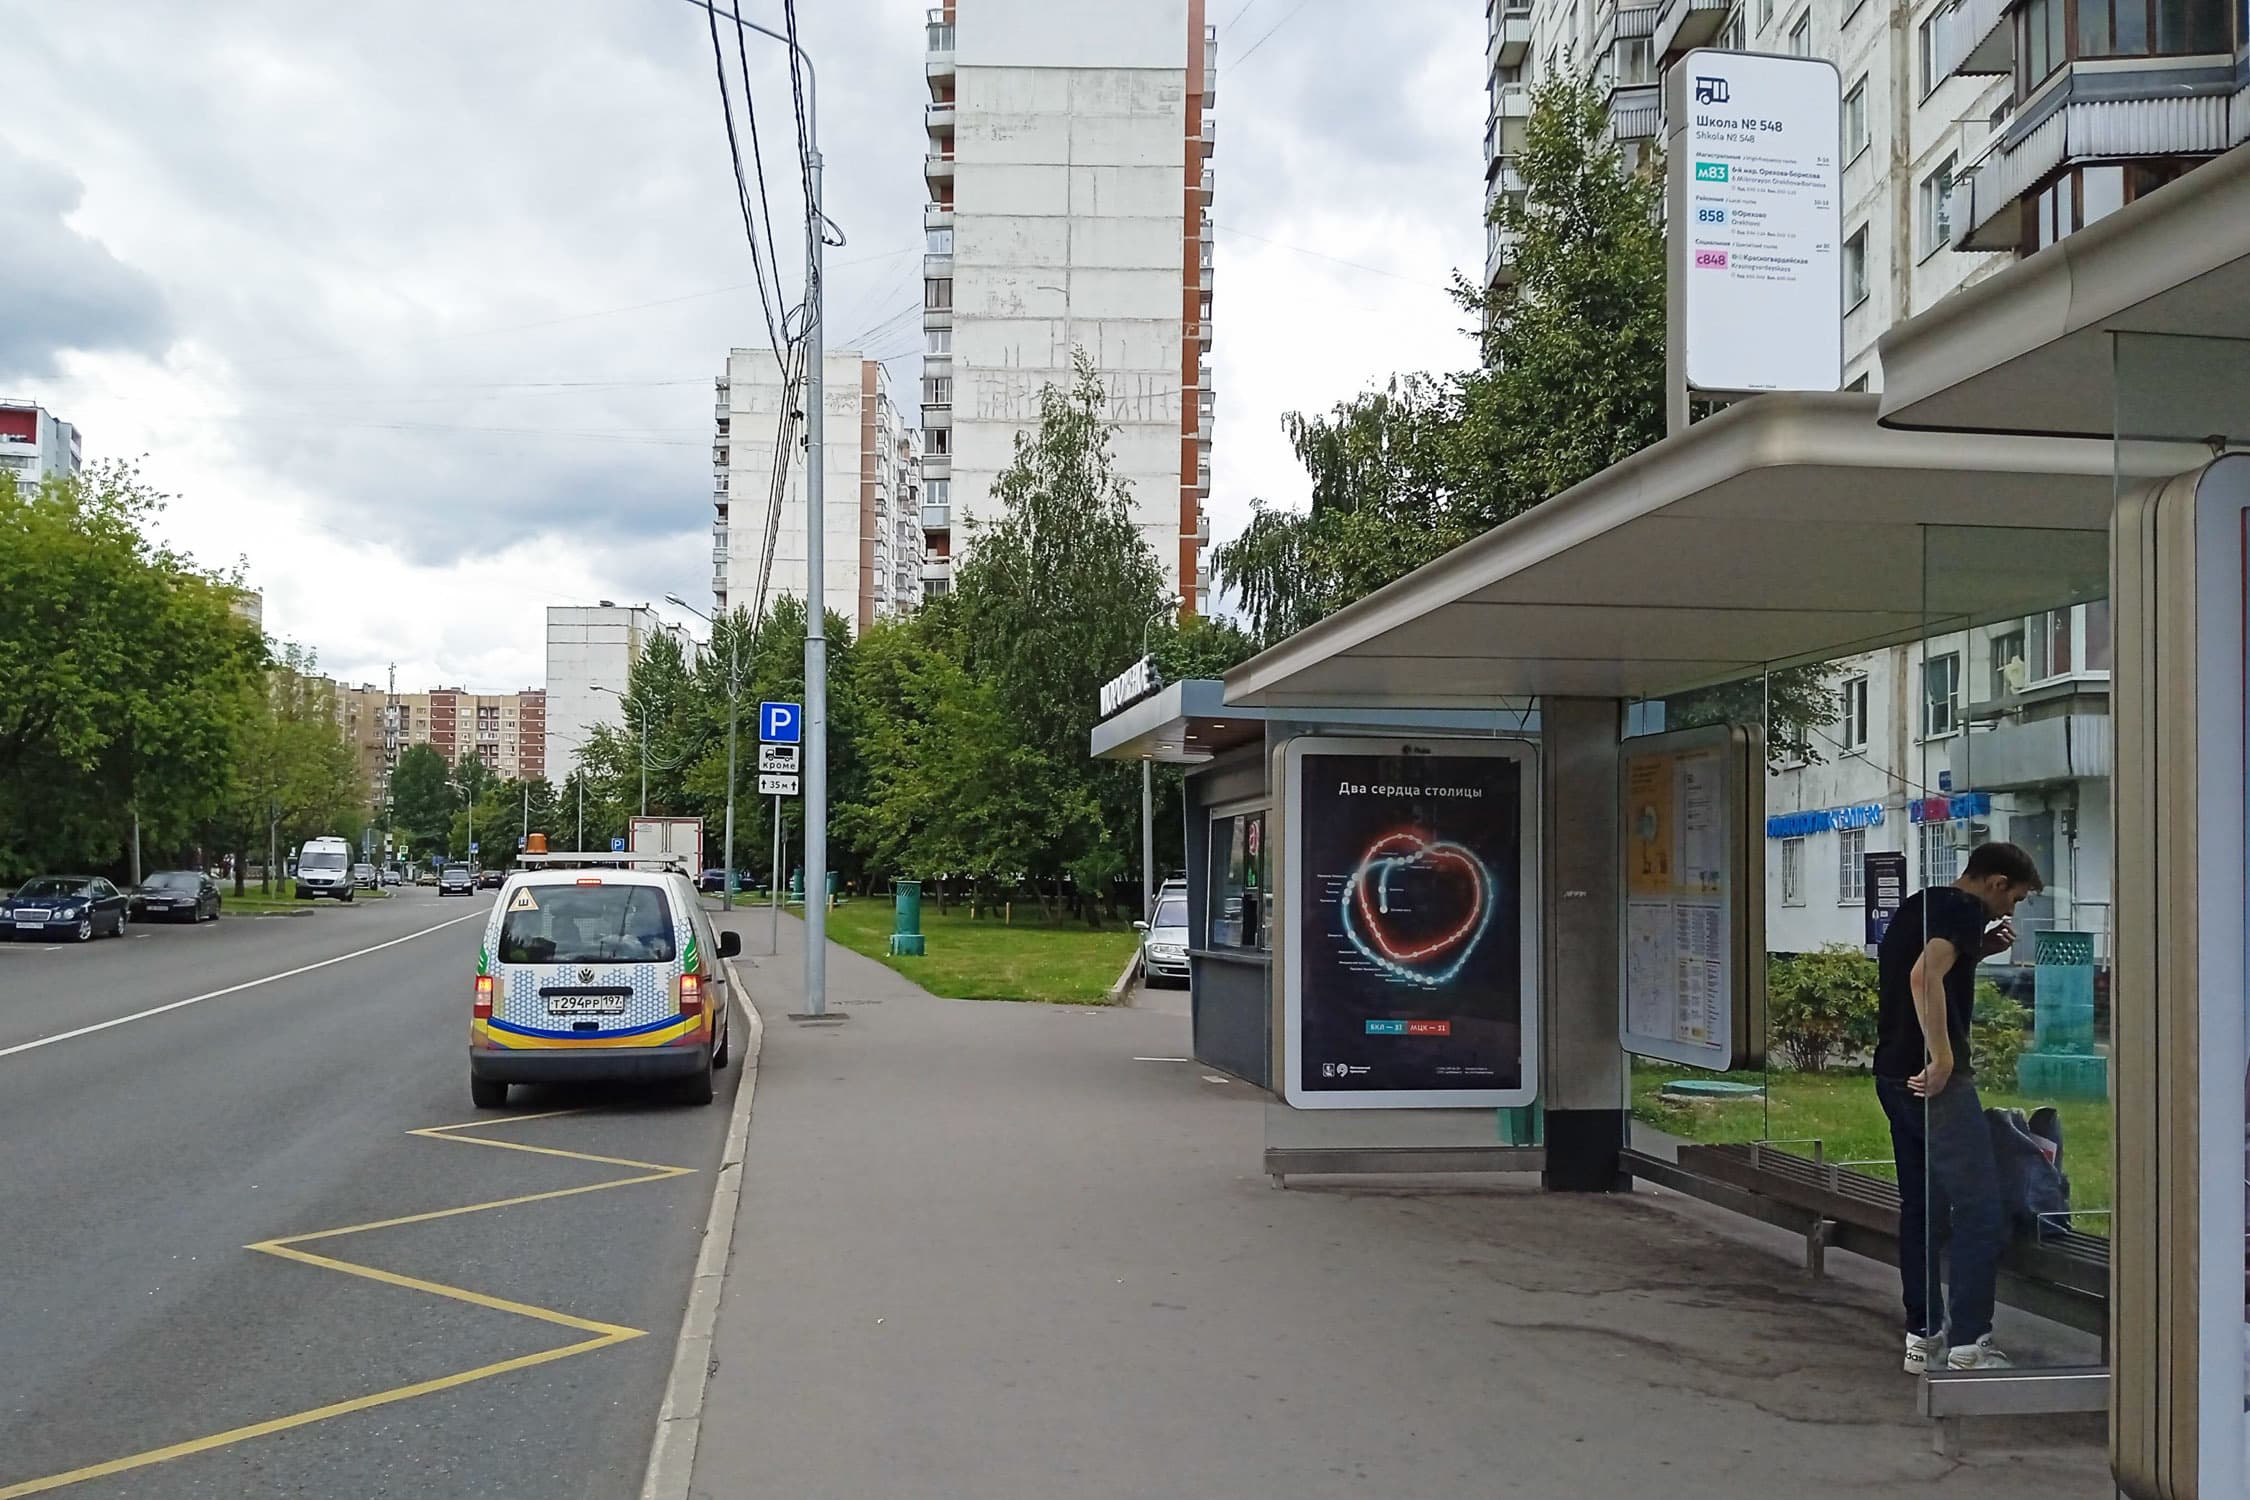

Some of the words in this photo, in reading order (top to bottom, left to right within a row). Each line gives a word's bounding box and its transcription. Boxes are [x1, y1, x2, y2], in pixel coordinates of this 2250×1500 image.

[1696, 115, 1738, 129] Школа
[1741, 118, 1757, 130] №
[1760, 120, 1783, 132] 548
[1696, 131, 1724, 141] Shkola
[1739, 134, 1755, 143] 548
[1697, 166, 1725, 179] м83
[1698, 209, 1725, 222] 858
[1697, 254, 1726, 266] с848
[770, 707, 792, 737] P
[762, 761, 796, 770] кроме
[1339, 781, 1367, 796] Два
[1371, 784, 1420, 797] сердца
[1424, 787, 1482, 799] столицы
[1410, 1024, 1428, 1032] МЦК
